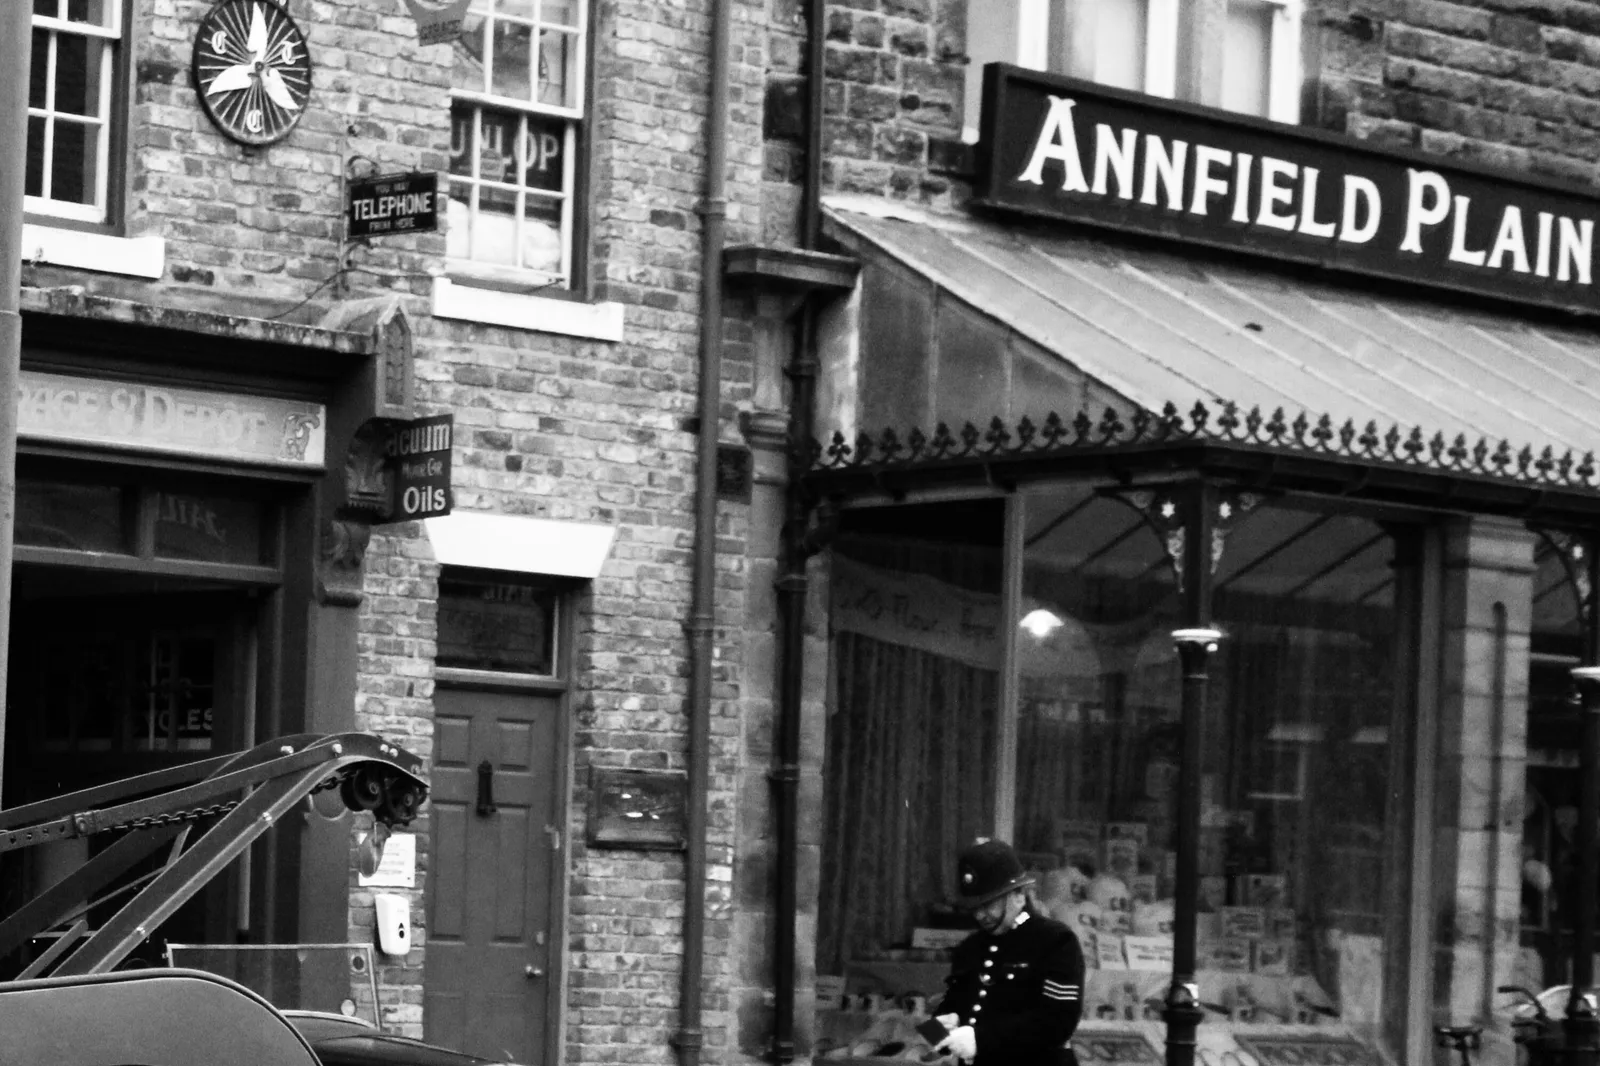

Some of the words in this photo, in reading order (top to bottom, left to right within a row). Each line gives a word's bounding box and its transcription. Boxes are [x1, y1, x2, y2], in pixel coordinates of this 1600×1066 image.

[1017, 94, 1383, 245] ANNFIELD
[1399, 167, 1595, 286] PLAIN
[352, 191, 433, 221] TELEPHONE
[403, 485, 447, 514] Oils
